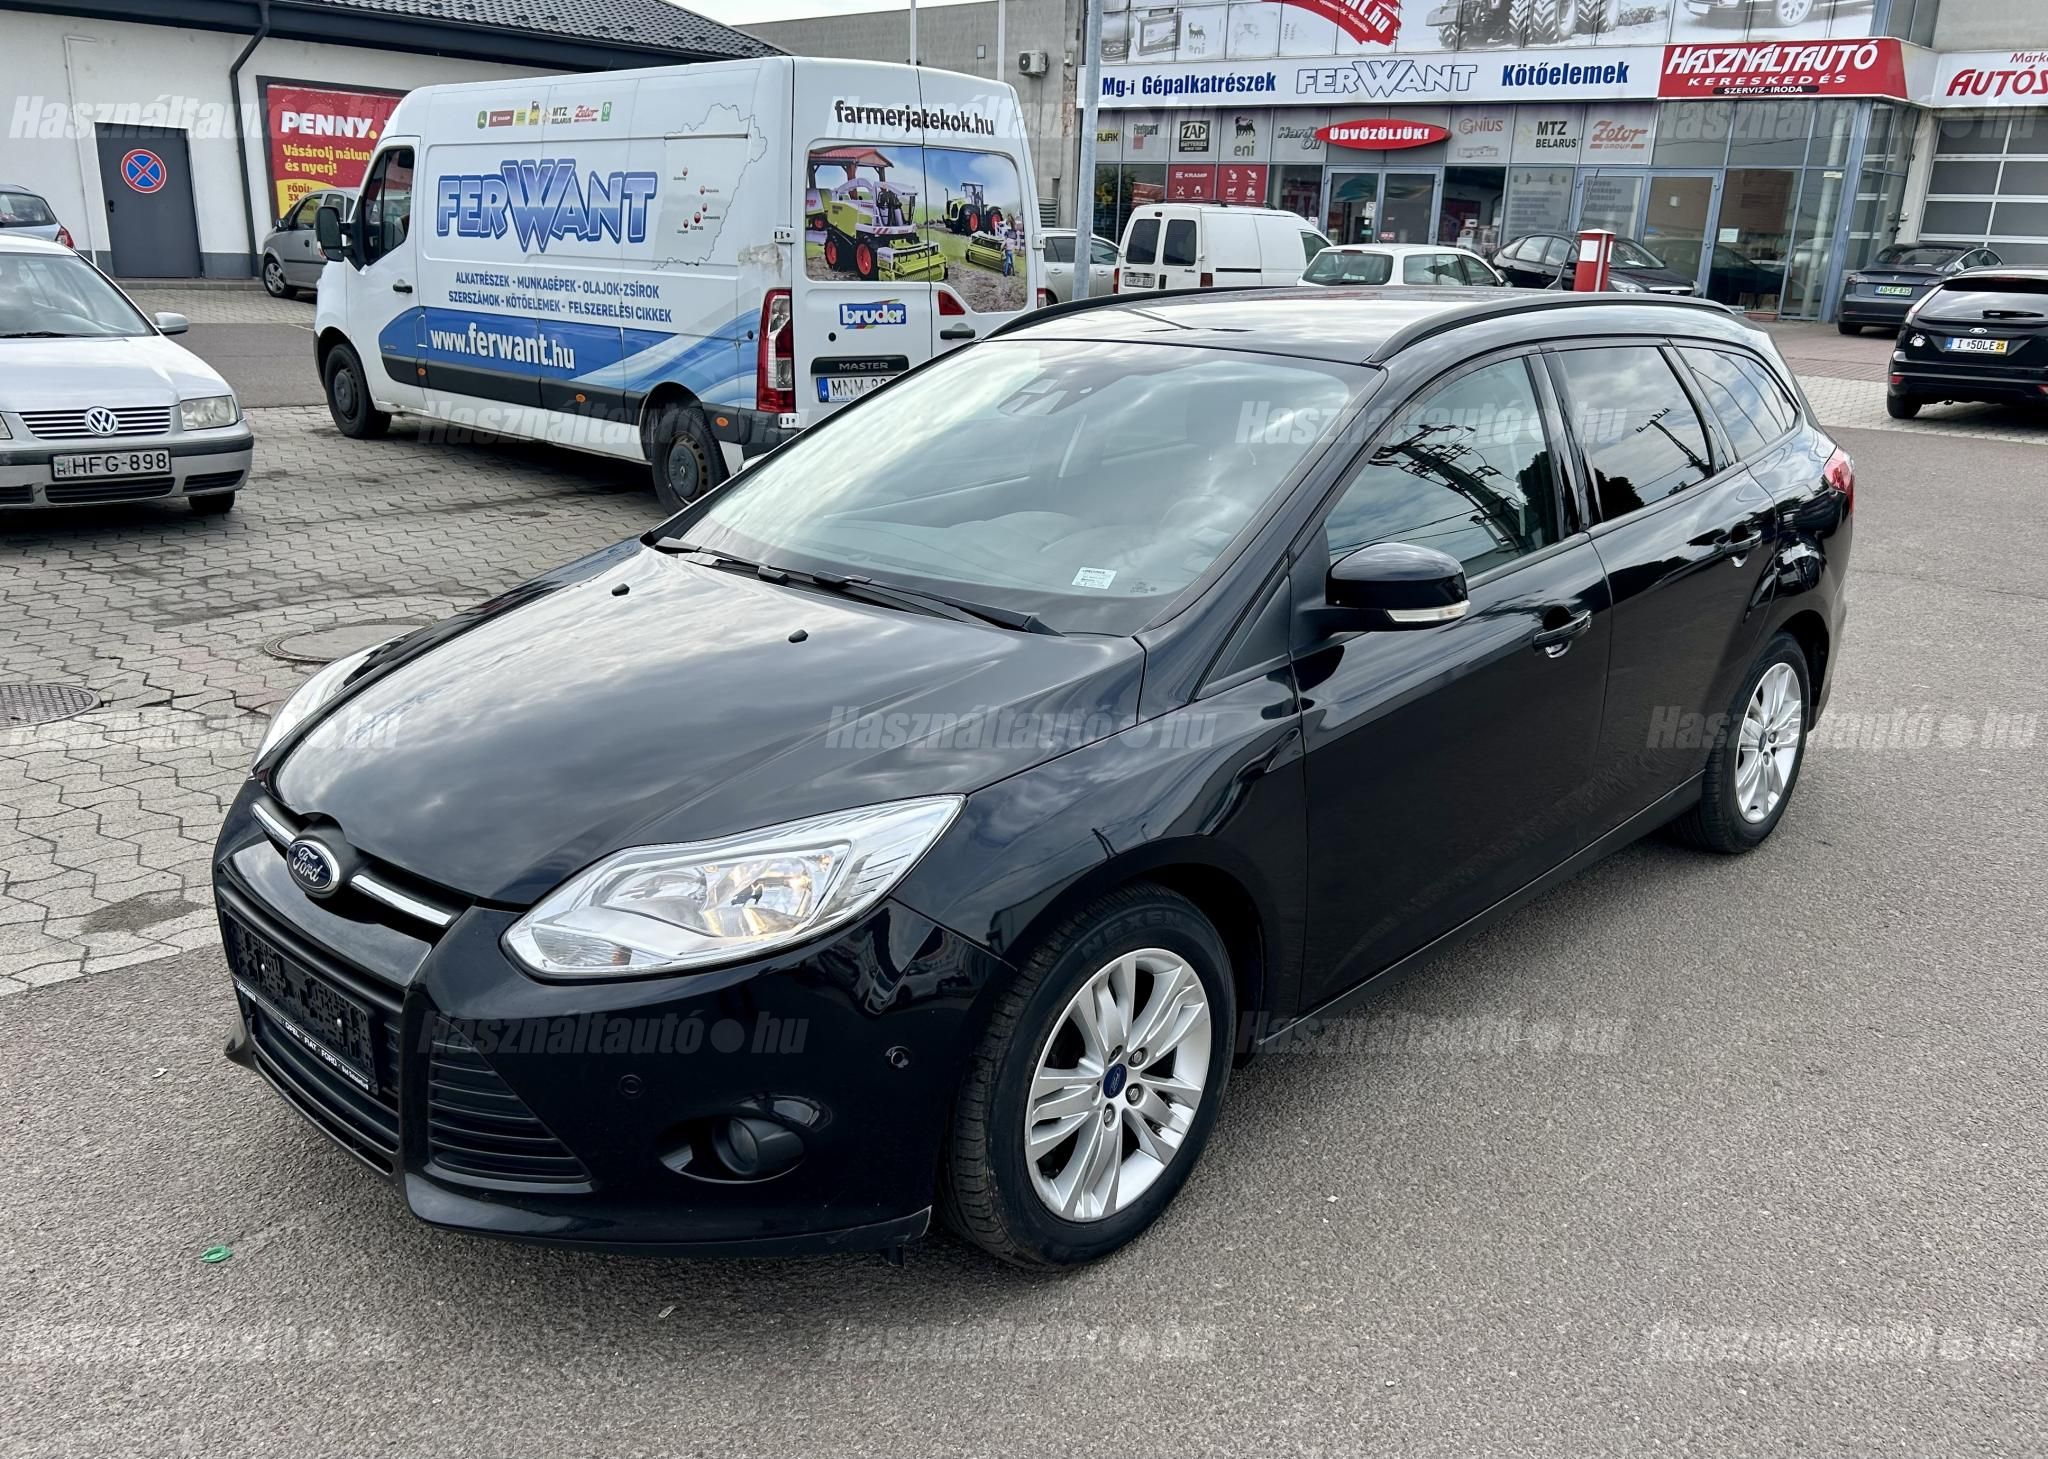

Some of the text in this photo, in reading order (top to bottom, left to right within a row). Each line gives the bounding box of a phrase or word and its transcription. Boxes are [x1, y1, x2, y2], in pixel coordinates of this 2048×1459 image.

[1665, 40, 1879, 75] HASZNÁLTAUTÓ
[2010, 51, 2048, 63] Márk
[1102, 72, 1276, 97] Mg-i Gépalkatrészek
[1501, 61, 1630, 87] Kötőelemek
[1687, 74, 1847, 87] KERESKEDÉS
[834, 100, 995, 136] farmerjatekok.hu
[1537, 121, 1567, 136] MTZ
[1183, 124, 1206, 138] ZAP
[1328, 127, 1429, 141] ÜDVÖZÖLJÜK!
[1592, 120, 1649, 143] Zetor
[283, 144, 333, 160] Vásárolj
[1233, 140, 1255, 157] eni
[1535, 138, 1578, 149] BELARUS
[285, 159, 337, 176] és nyerj!
[437, 158, 657, 253] FERWANT
[456, 271, 510, 287] ALKATRÉSZEK
[517, 275, 576, 293] MUNKAGÉPEK
[448, 289, 500, 306] SZERSZÁMOK
[569, 300, 633, 320] FELSZERELÉSI
[635, 307, 672, 323] CIKKEK
[842, 304, 904, 324] bruder
[430, 321, 576, 370] www.ferwant.hu
[839, 362, 889, 370] MASTER
[73, 453, 167, 475] HFG-898
[293, 847, 323, 882] Ford
